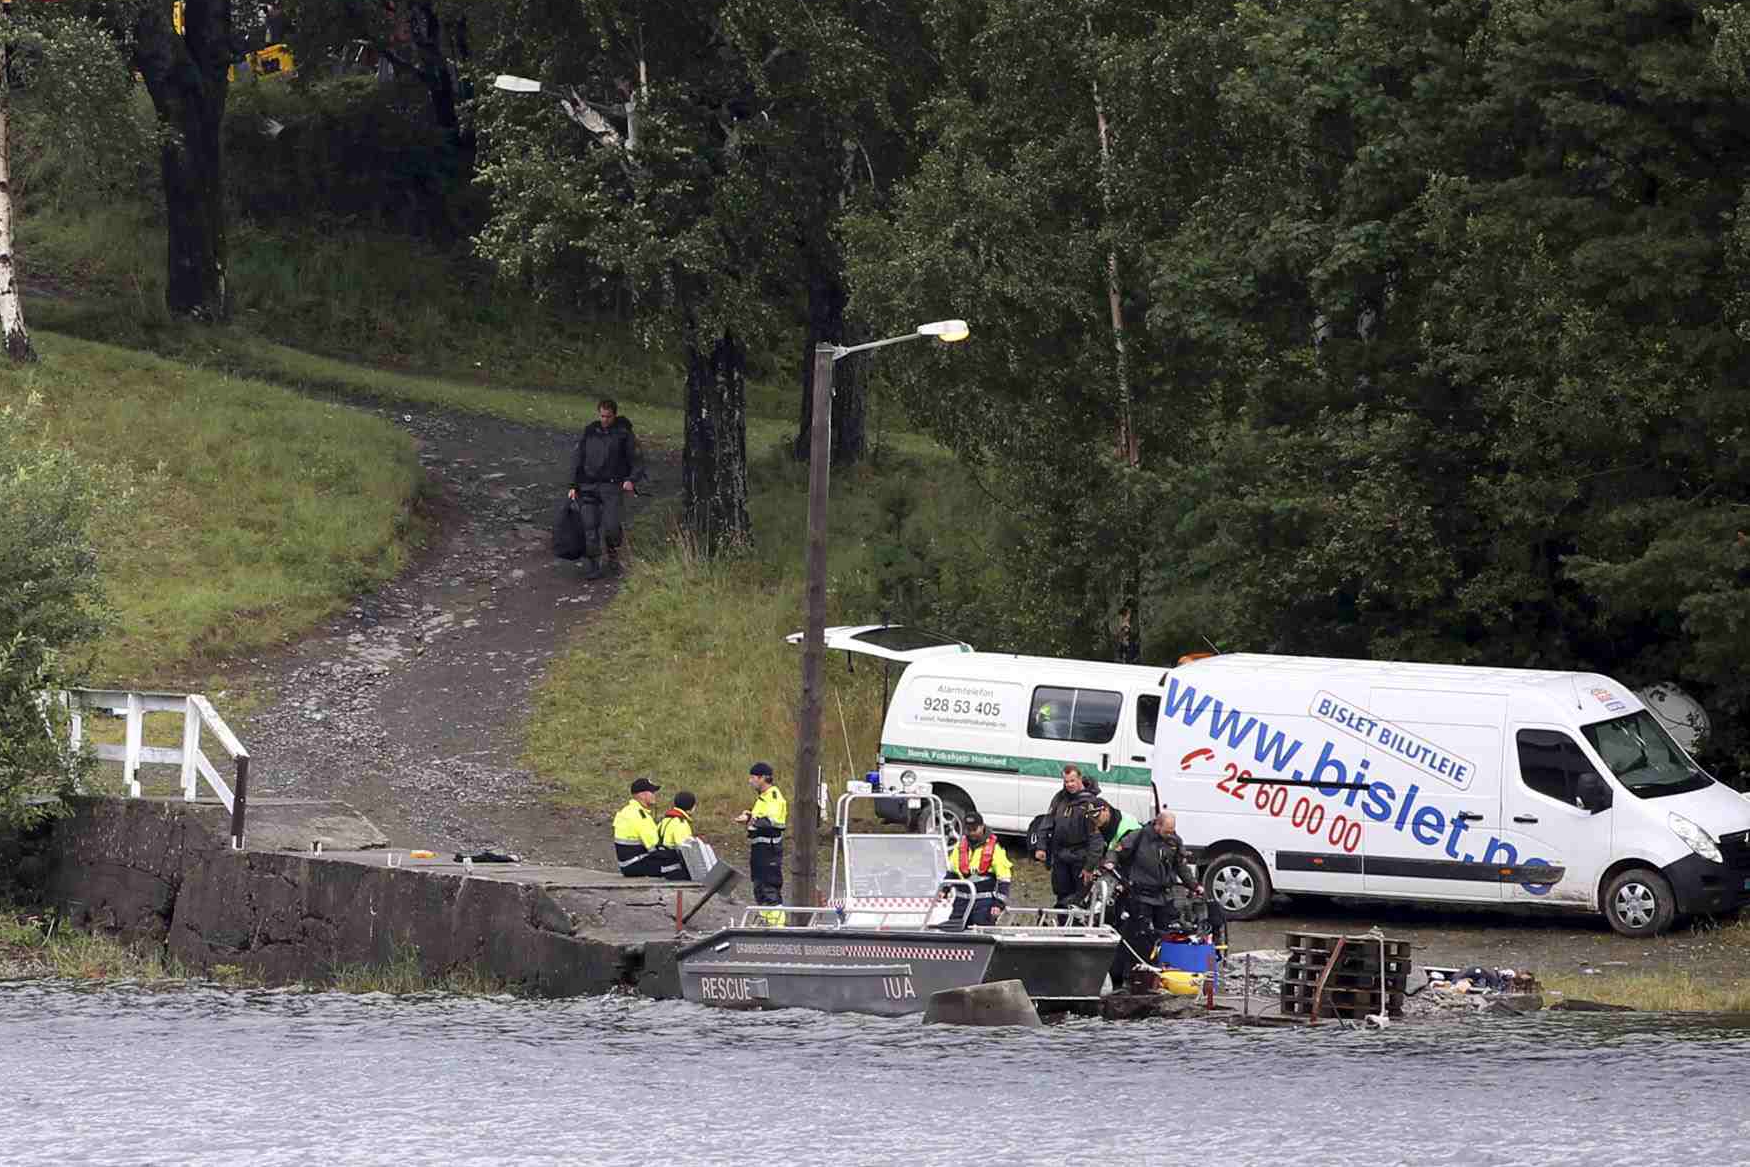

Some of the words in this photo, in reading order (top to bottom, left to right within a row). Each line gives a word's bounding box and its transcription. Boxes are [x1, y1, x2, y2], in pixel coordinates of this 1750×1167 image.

[923, 697, 950, 712] 928
[953, 699, 971, 714] 53
[974, 702, 1001, 716] 405
[1317, 698, 1378, 738] BISLET
[1378, 727, 1468, 783] BILUTLEIE
[1216, 763, 1252, 800] 22
[1255, 782, 1288, 817] 60
[1291, 797, 1325, 834] 00
[1328, 815, 1362, 852] 00
[701, 977, 752, 1001] RESCUE
[883, 977, 916, 999] IUA
